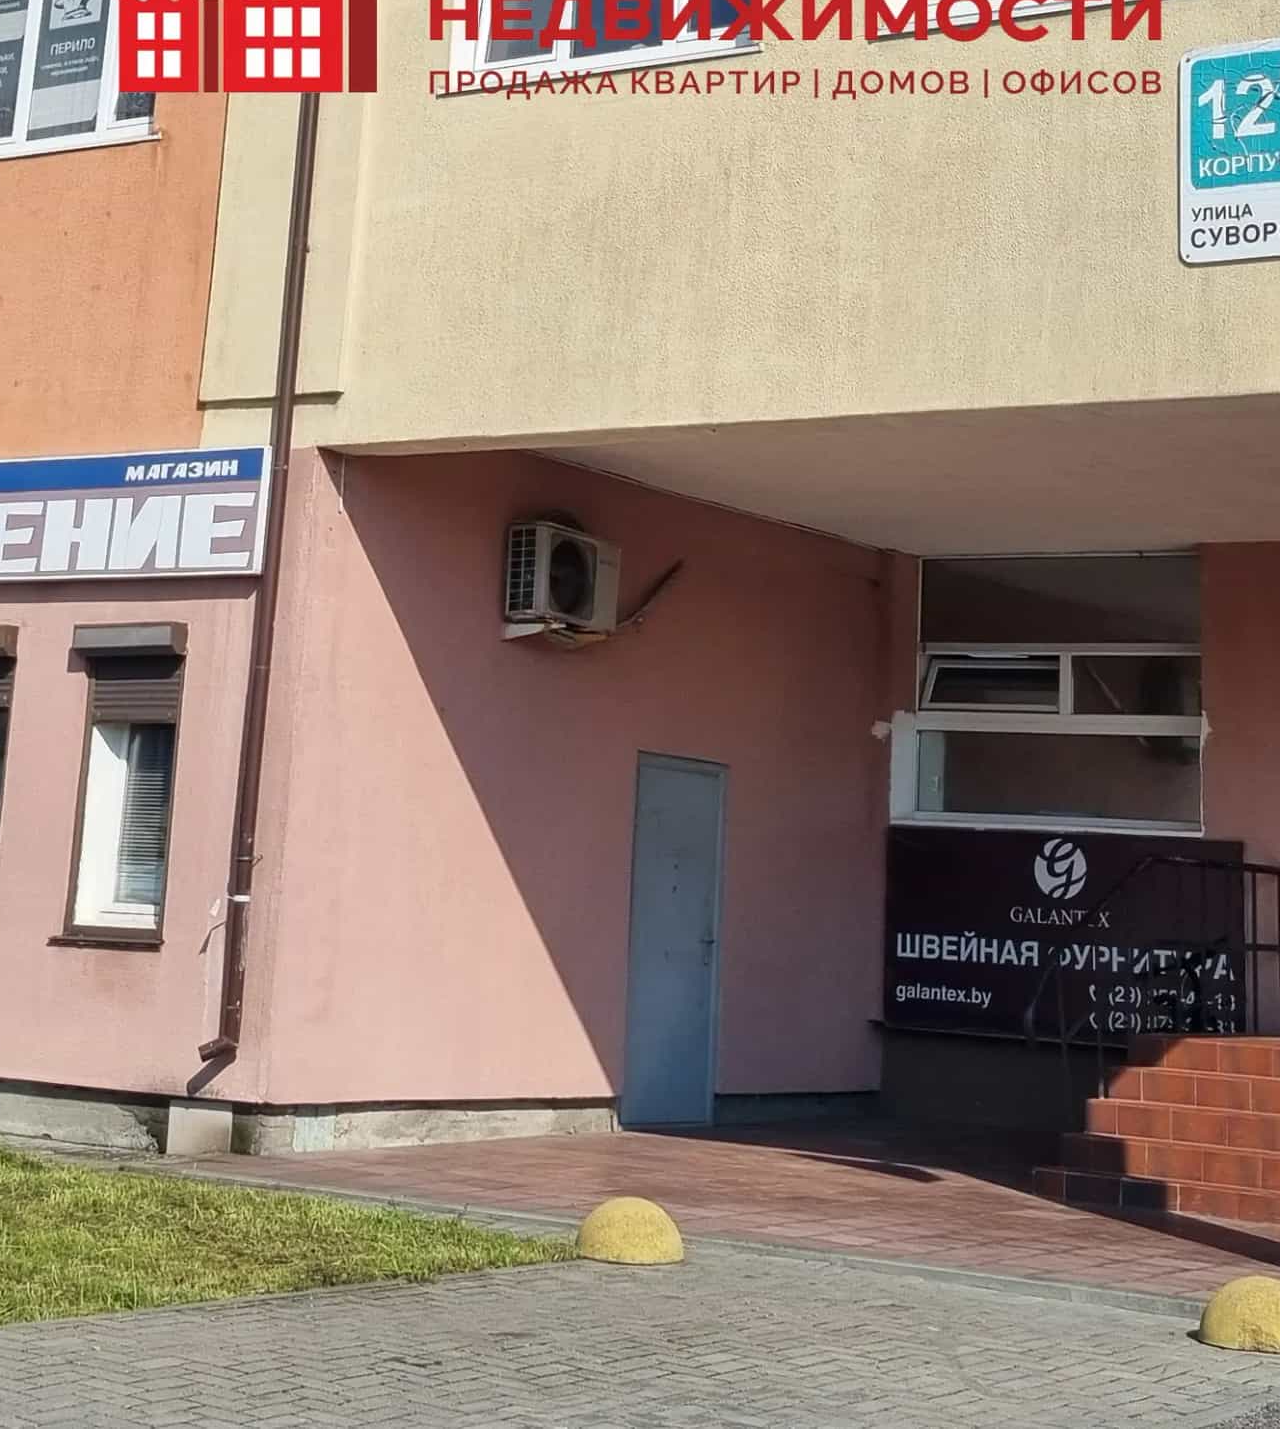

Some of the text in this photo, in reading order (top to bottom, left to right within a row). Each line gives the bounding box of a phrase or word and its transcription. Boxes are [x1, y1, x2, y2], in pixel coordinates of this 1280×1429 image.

[50, 37, 96, 56] ПЕРИЛО
[1191, 203, 1253, 223] УЛИЦА
[125, 459, 238, 482] МАГАЗИН
[1010, 906, 1111, 928] GALANTX
[896, 932, 1236, 982] ШВЕЙНАЯ УРНИТА
[895, 983, 993, 1009] galantex.by
